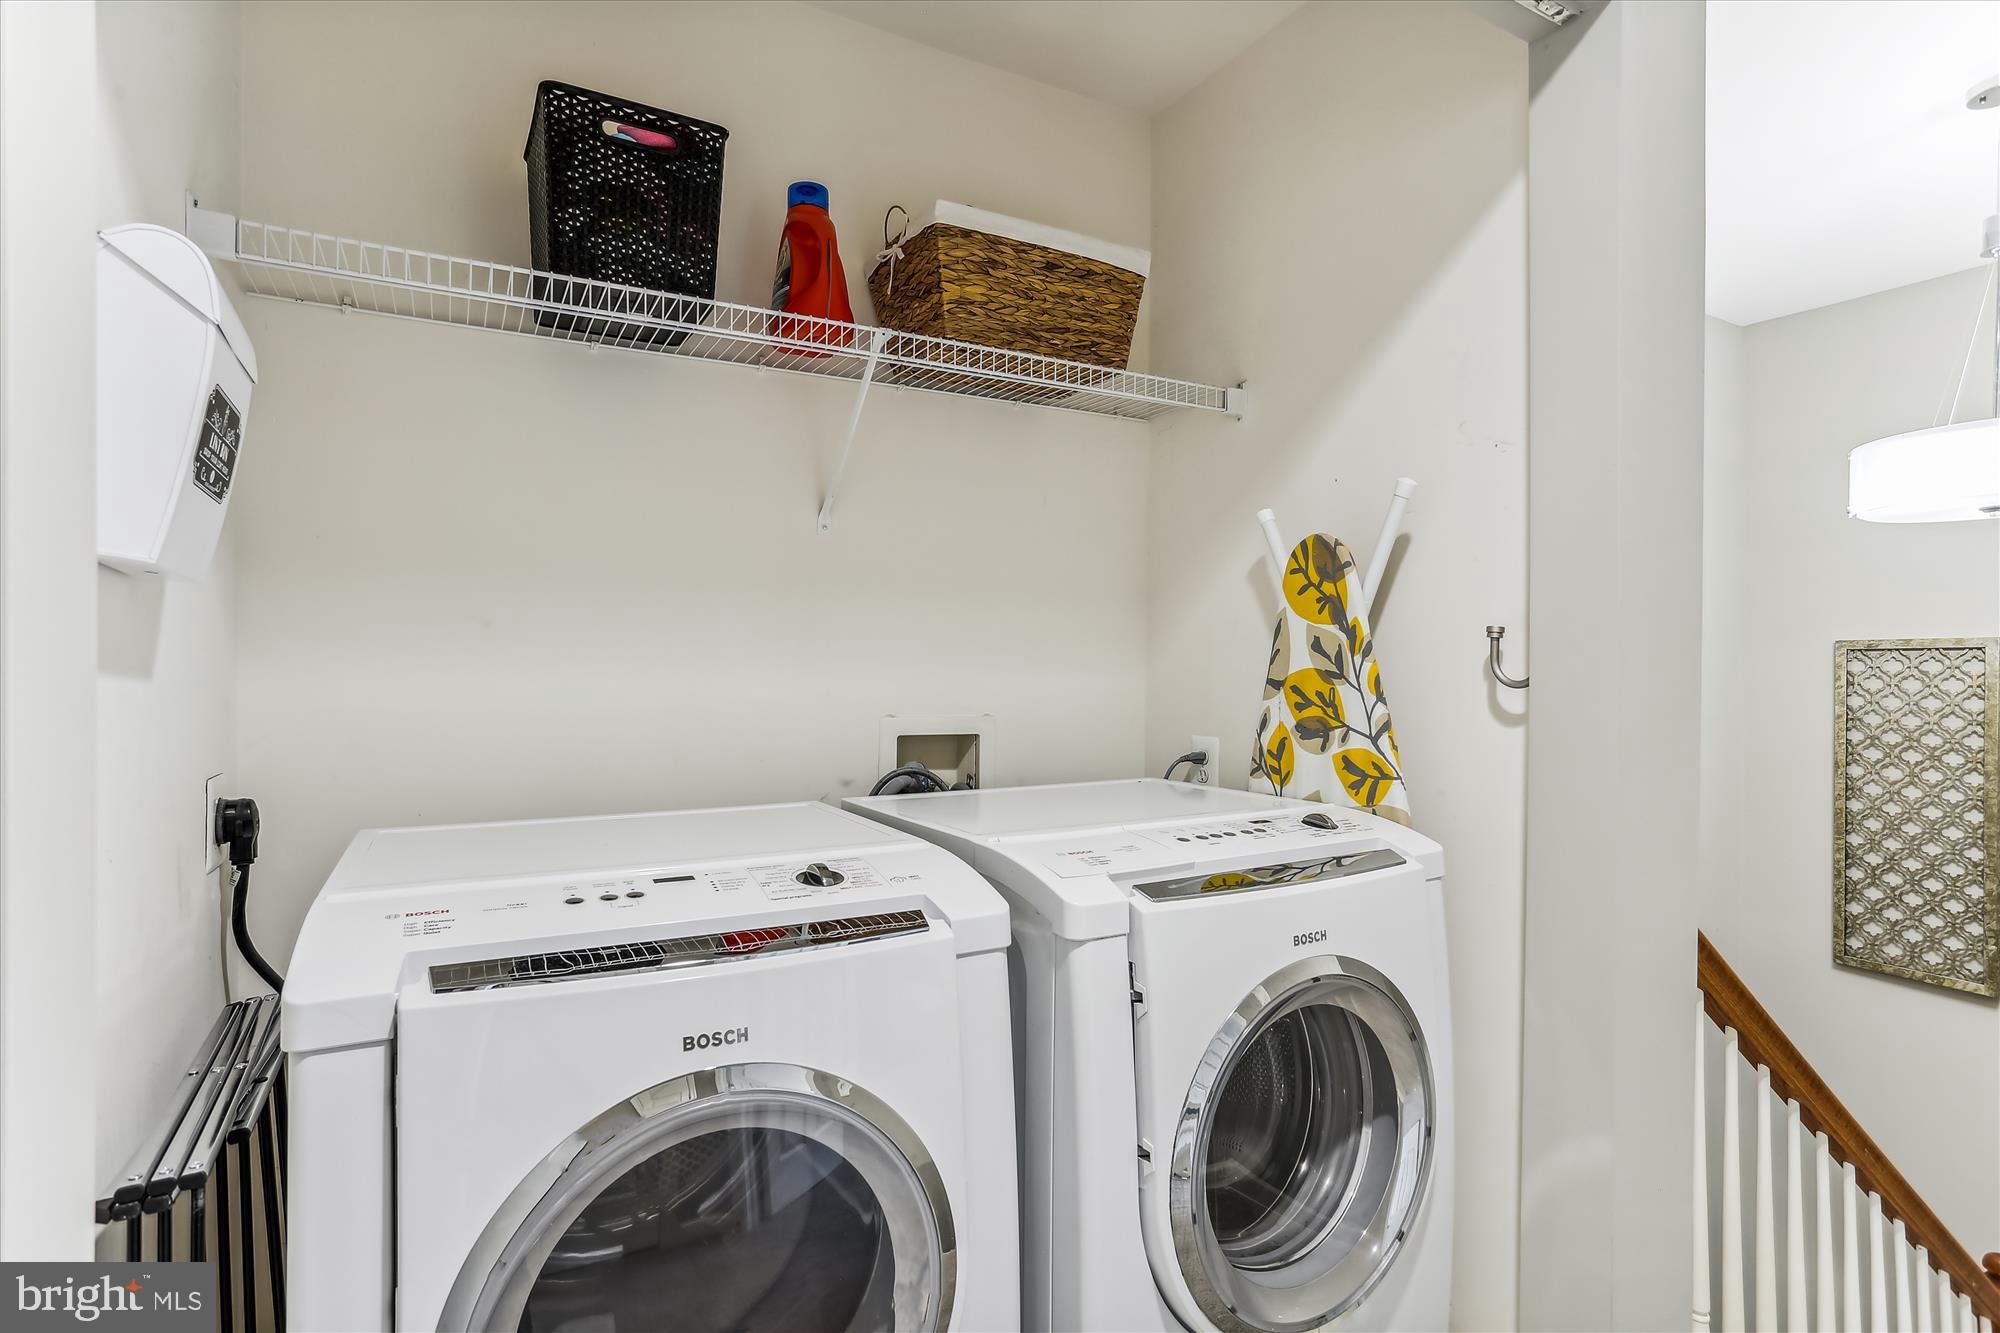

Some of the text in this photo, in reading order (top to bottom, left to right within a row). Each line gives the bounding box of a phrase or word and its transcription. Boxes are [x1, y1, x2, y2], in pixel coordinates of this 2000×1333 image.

[405, 909, 449, 917] BOSCH
[1293, 929, 1327, 947] BOSCH
[683, 1027, 748, 1052] BOSCH
